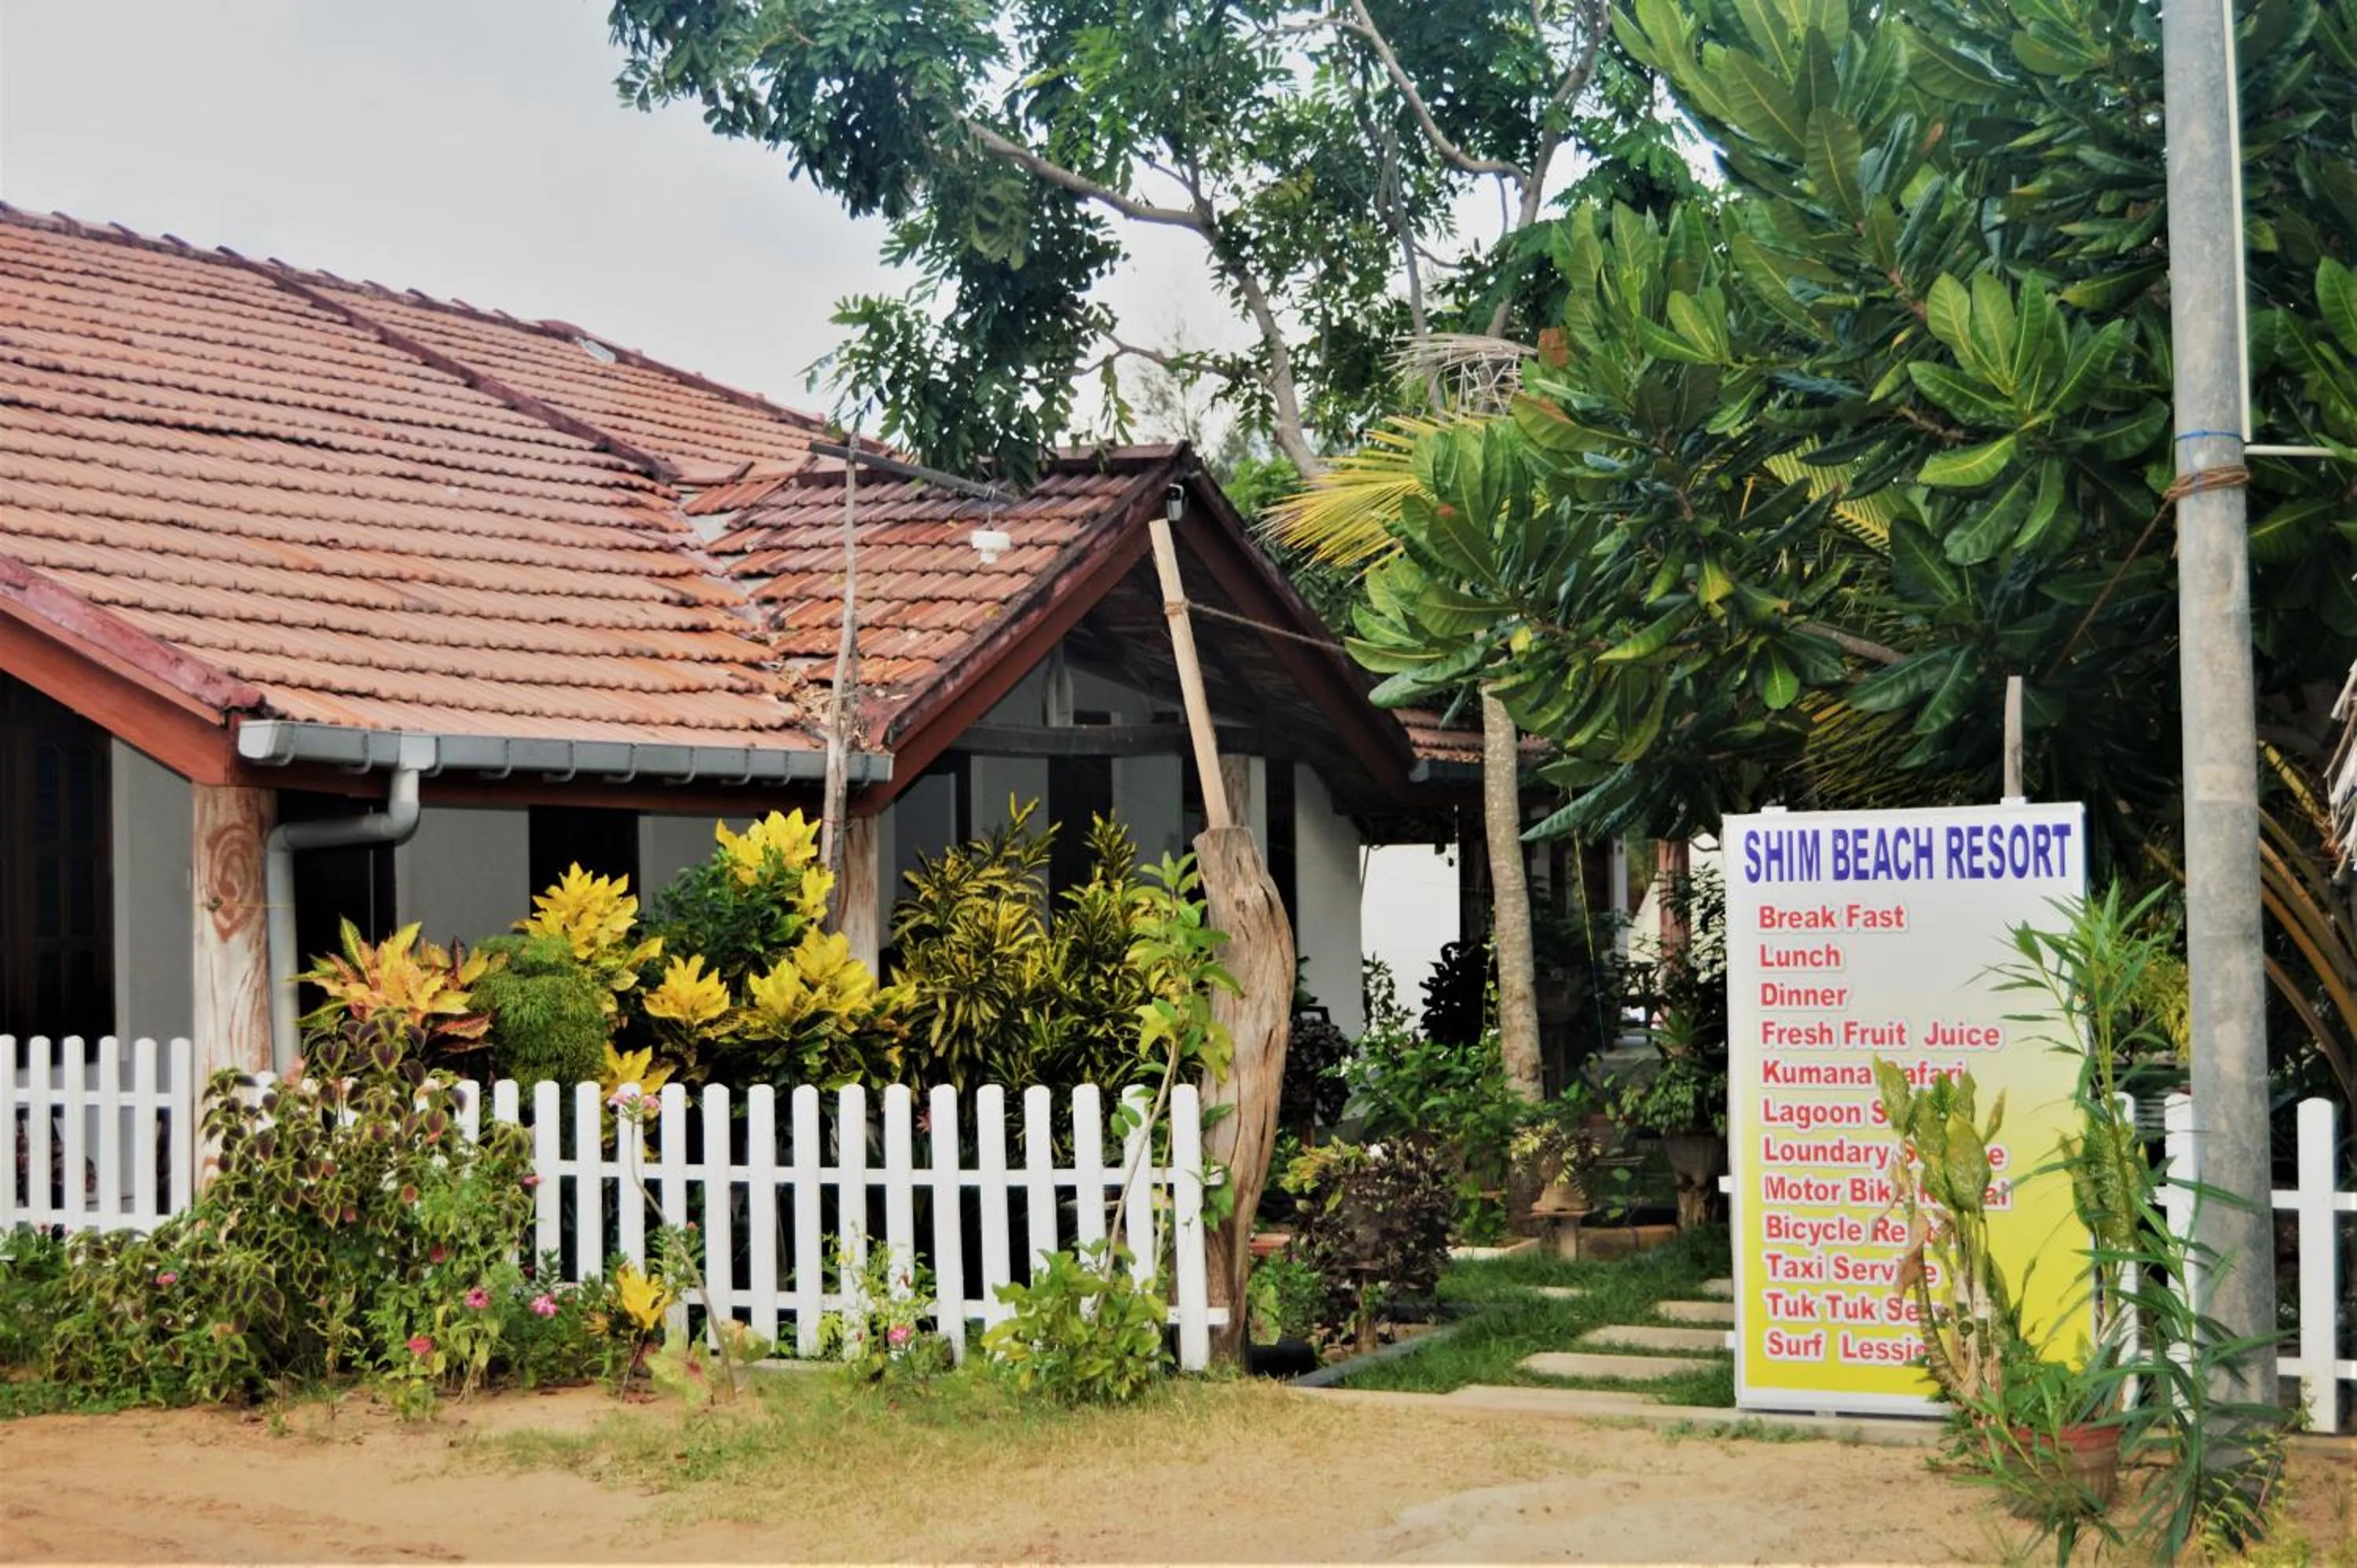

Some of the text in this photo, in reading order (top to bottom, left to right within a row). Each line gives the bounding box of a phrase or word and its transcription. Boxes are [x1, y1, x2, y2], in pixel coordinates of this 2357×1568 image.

[1744, 823, 2072, 883] SHIM BEACH RESORT
[1758, 904, 1905, 929] Break Fast
[1759, 943, 1841, 967] Lunch
[1760, 983, 1848, 1006] Dinner
[1761, 1022, 2000, 1046] Fresh Fruit Juice
[1762, 1061, 1963, 1085] Kumana afari
[1763, 1098, 1861, 1128] Lagoon
[1764, 1137, 1890, 1169] Loundary
[1765, 1176, 1840, 1202] Motor
[1849, 1178, 1904, 1202] Bik
[1766, 1214, 1861, 1246] Bicycle
[1766, 1255, 1937, 1282] Taxi Serve
[1766, 1292, 1816, 1317] Tuk
[1826, 1295, 1876, 1319] Tuk
[1768, 1332, 1822, 1357] Surf
